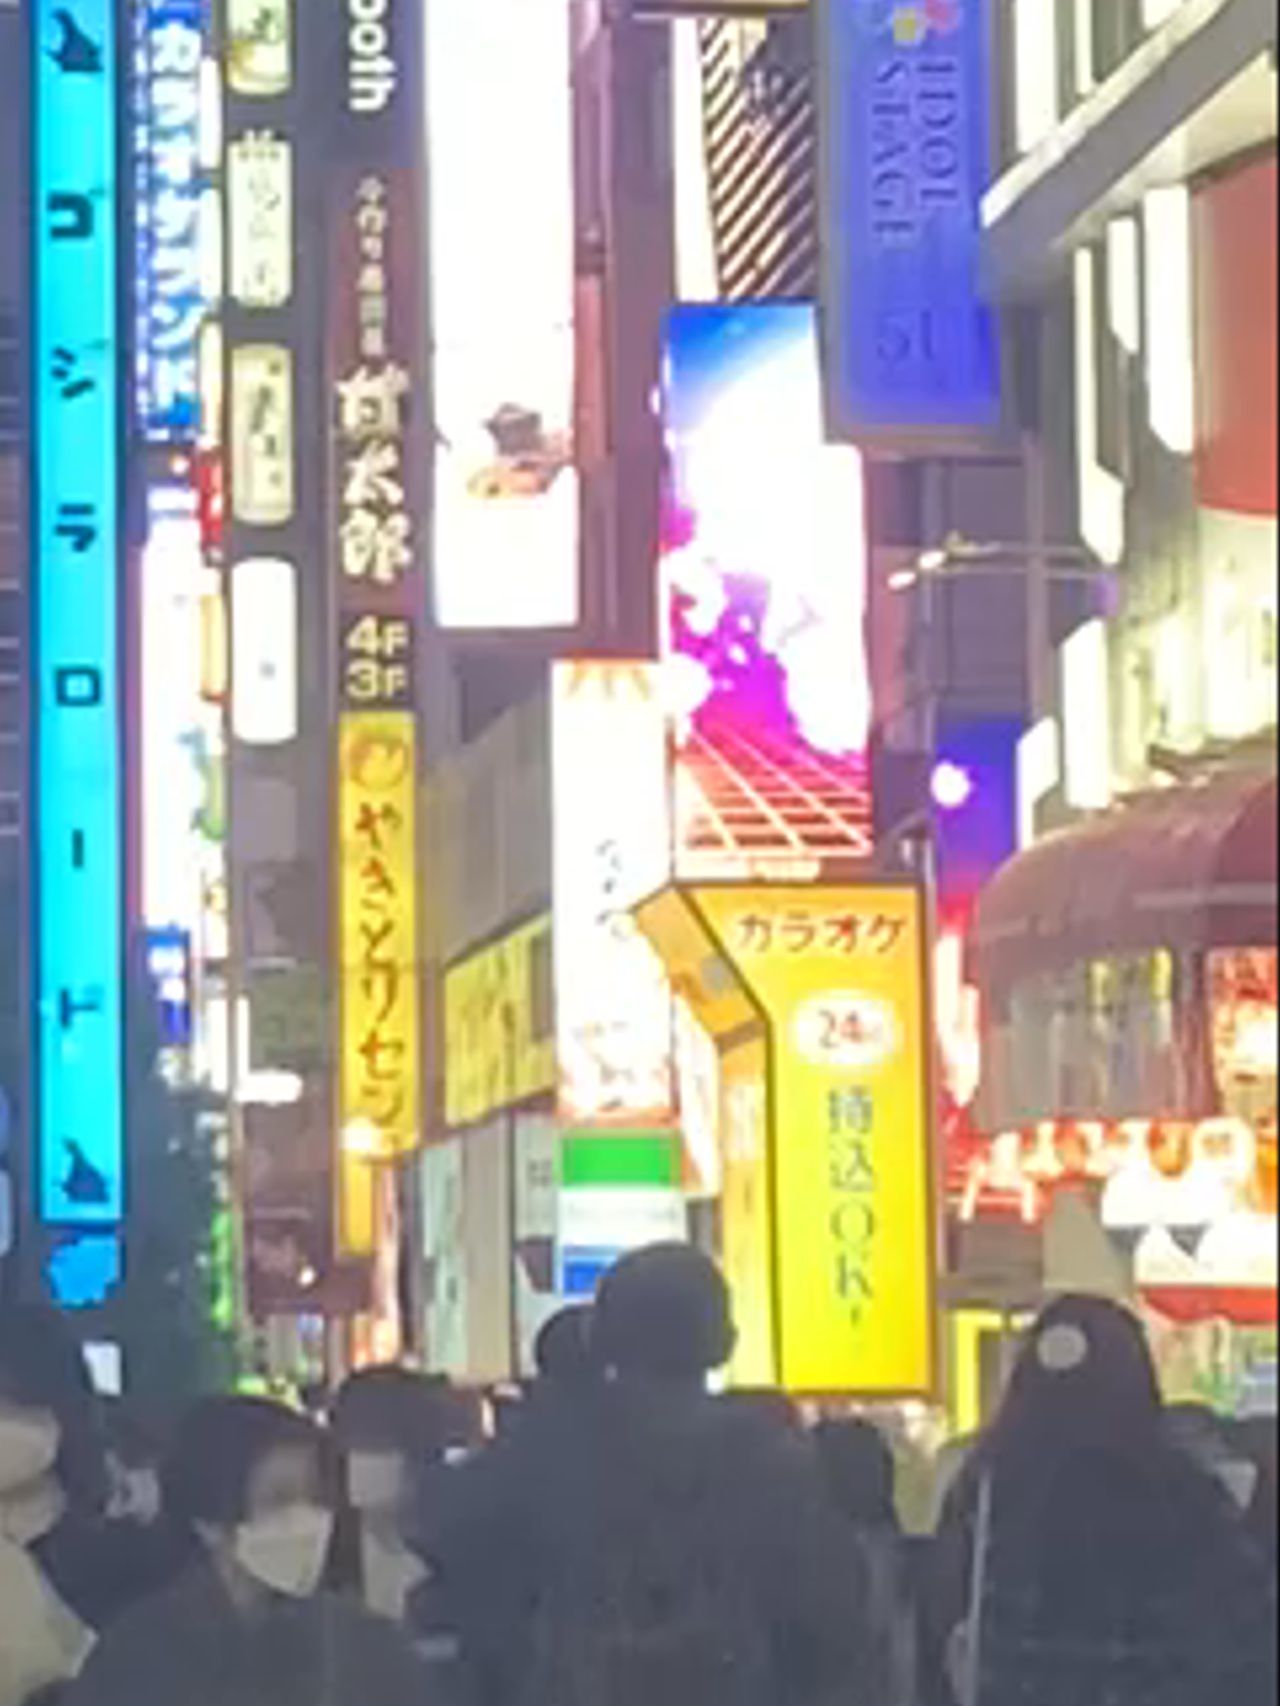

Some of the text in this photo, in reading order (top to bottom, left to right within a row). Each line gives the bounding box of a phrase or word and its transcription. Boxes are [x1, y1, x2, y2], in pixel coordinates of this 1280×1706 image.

[47, 186, 109, 1028] ゴジラロード
[345, 615, 408, 655] 4F
[345, 659, 407, 699] 3F
[736, 911, 909, 957] カラオケ
